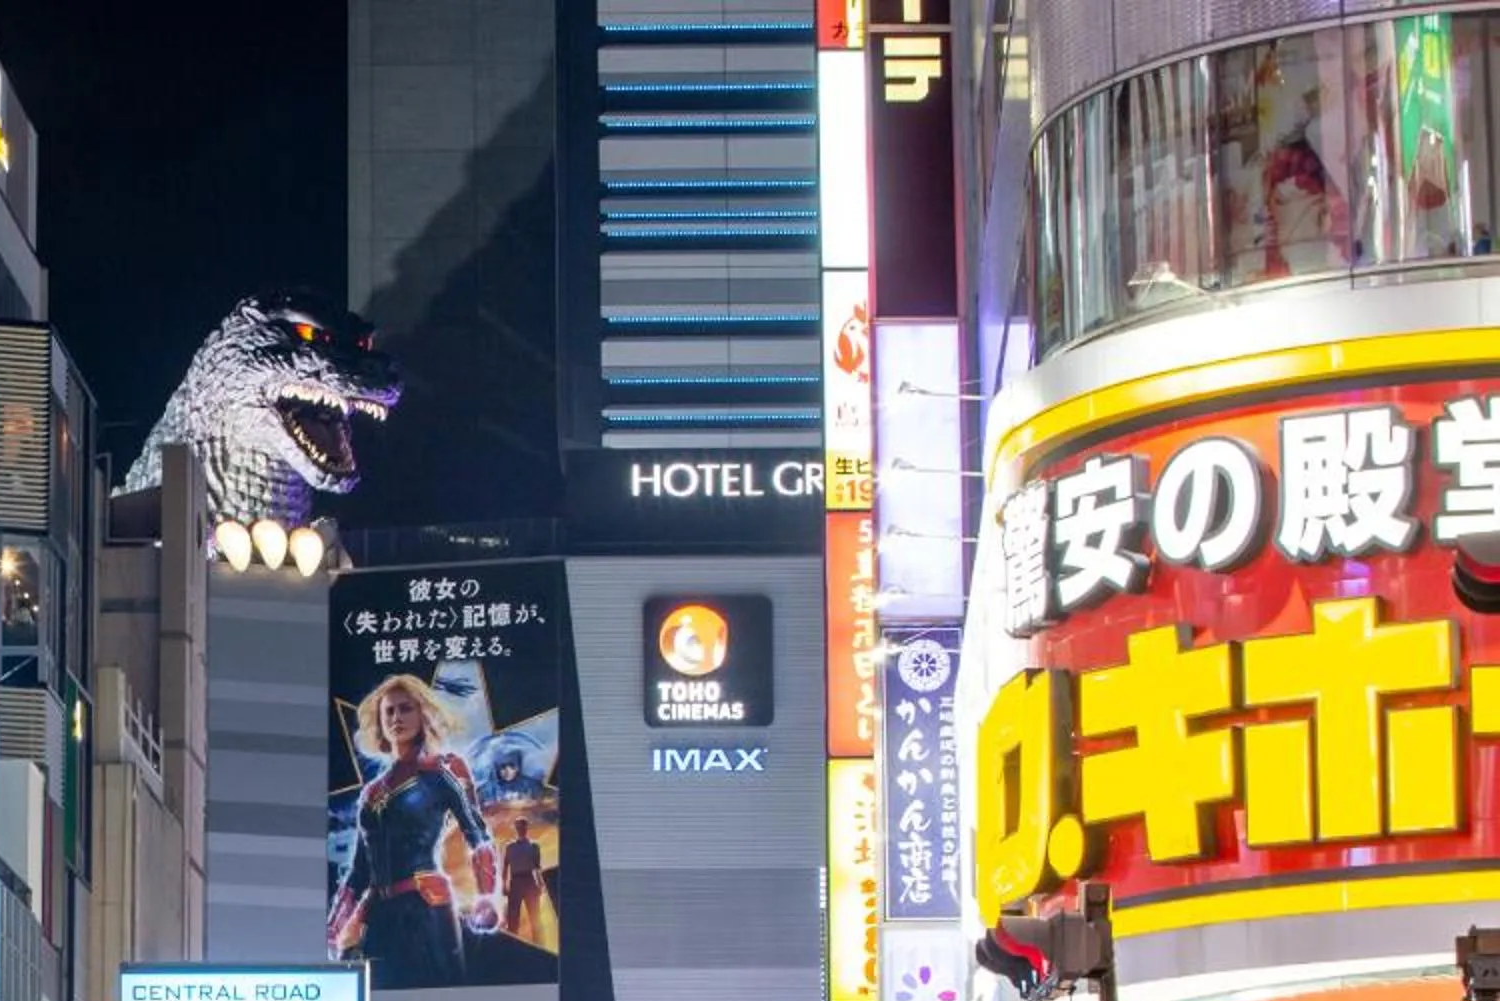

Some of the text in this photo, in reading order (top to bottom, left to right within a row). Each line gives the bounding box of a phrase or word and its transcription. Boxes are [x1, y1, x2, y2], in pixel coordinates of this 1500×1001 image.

[632, 463, 764, 497] HOTEL
[408, 576, 480, 602] 彼女の
[371, 635, 513, 664] 世界を変える。
[657, 682, 721, 703] TOHO
[657, 702, 745, 721] CINEMAS
[653, 749, 764, 771] IMAX
[132, 983, 321, 1001] CENTRAL ROAD
